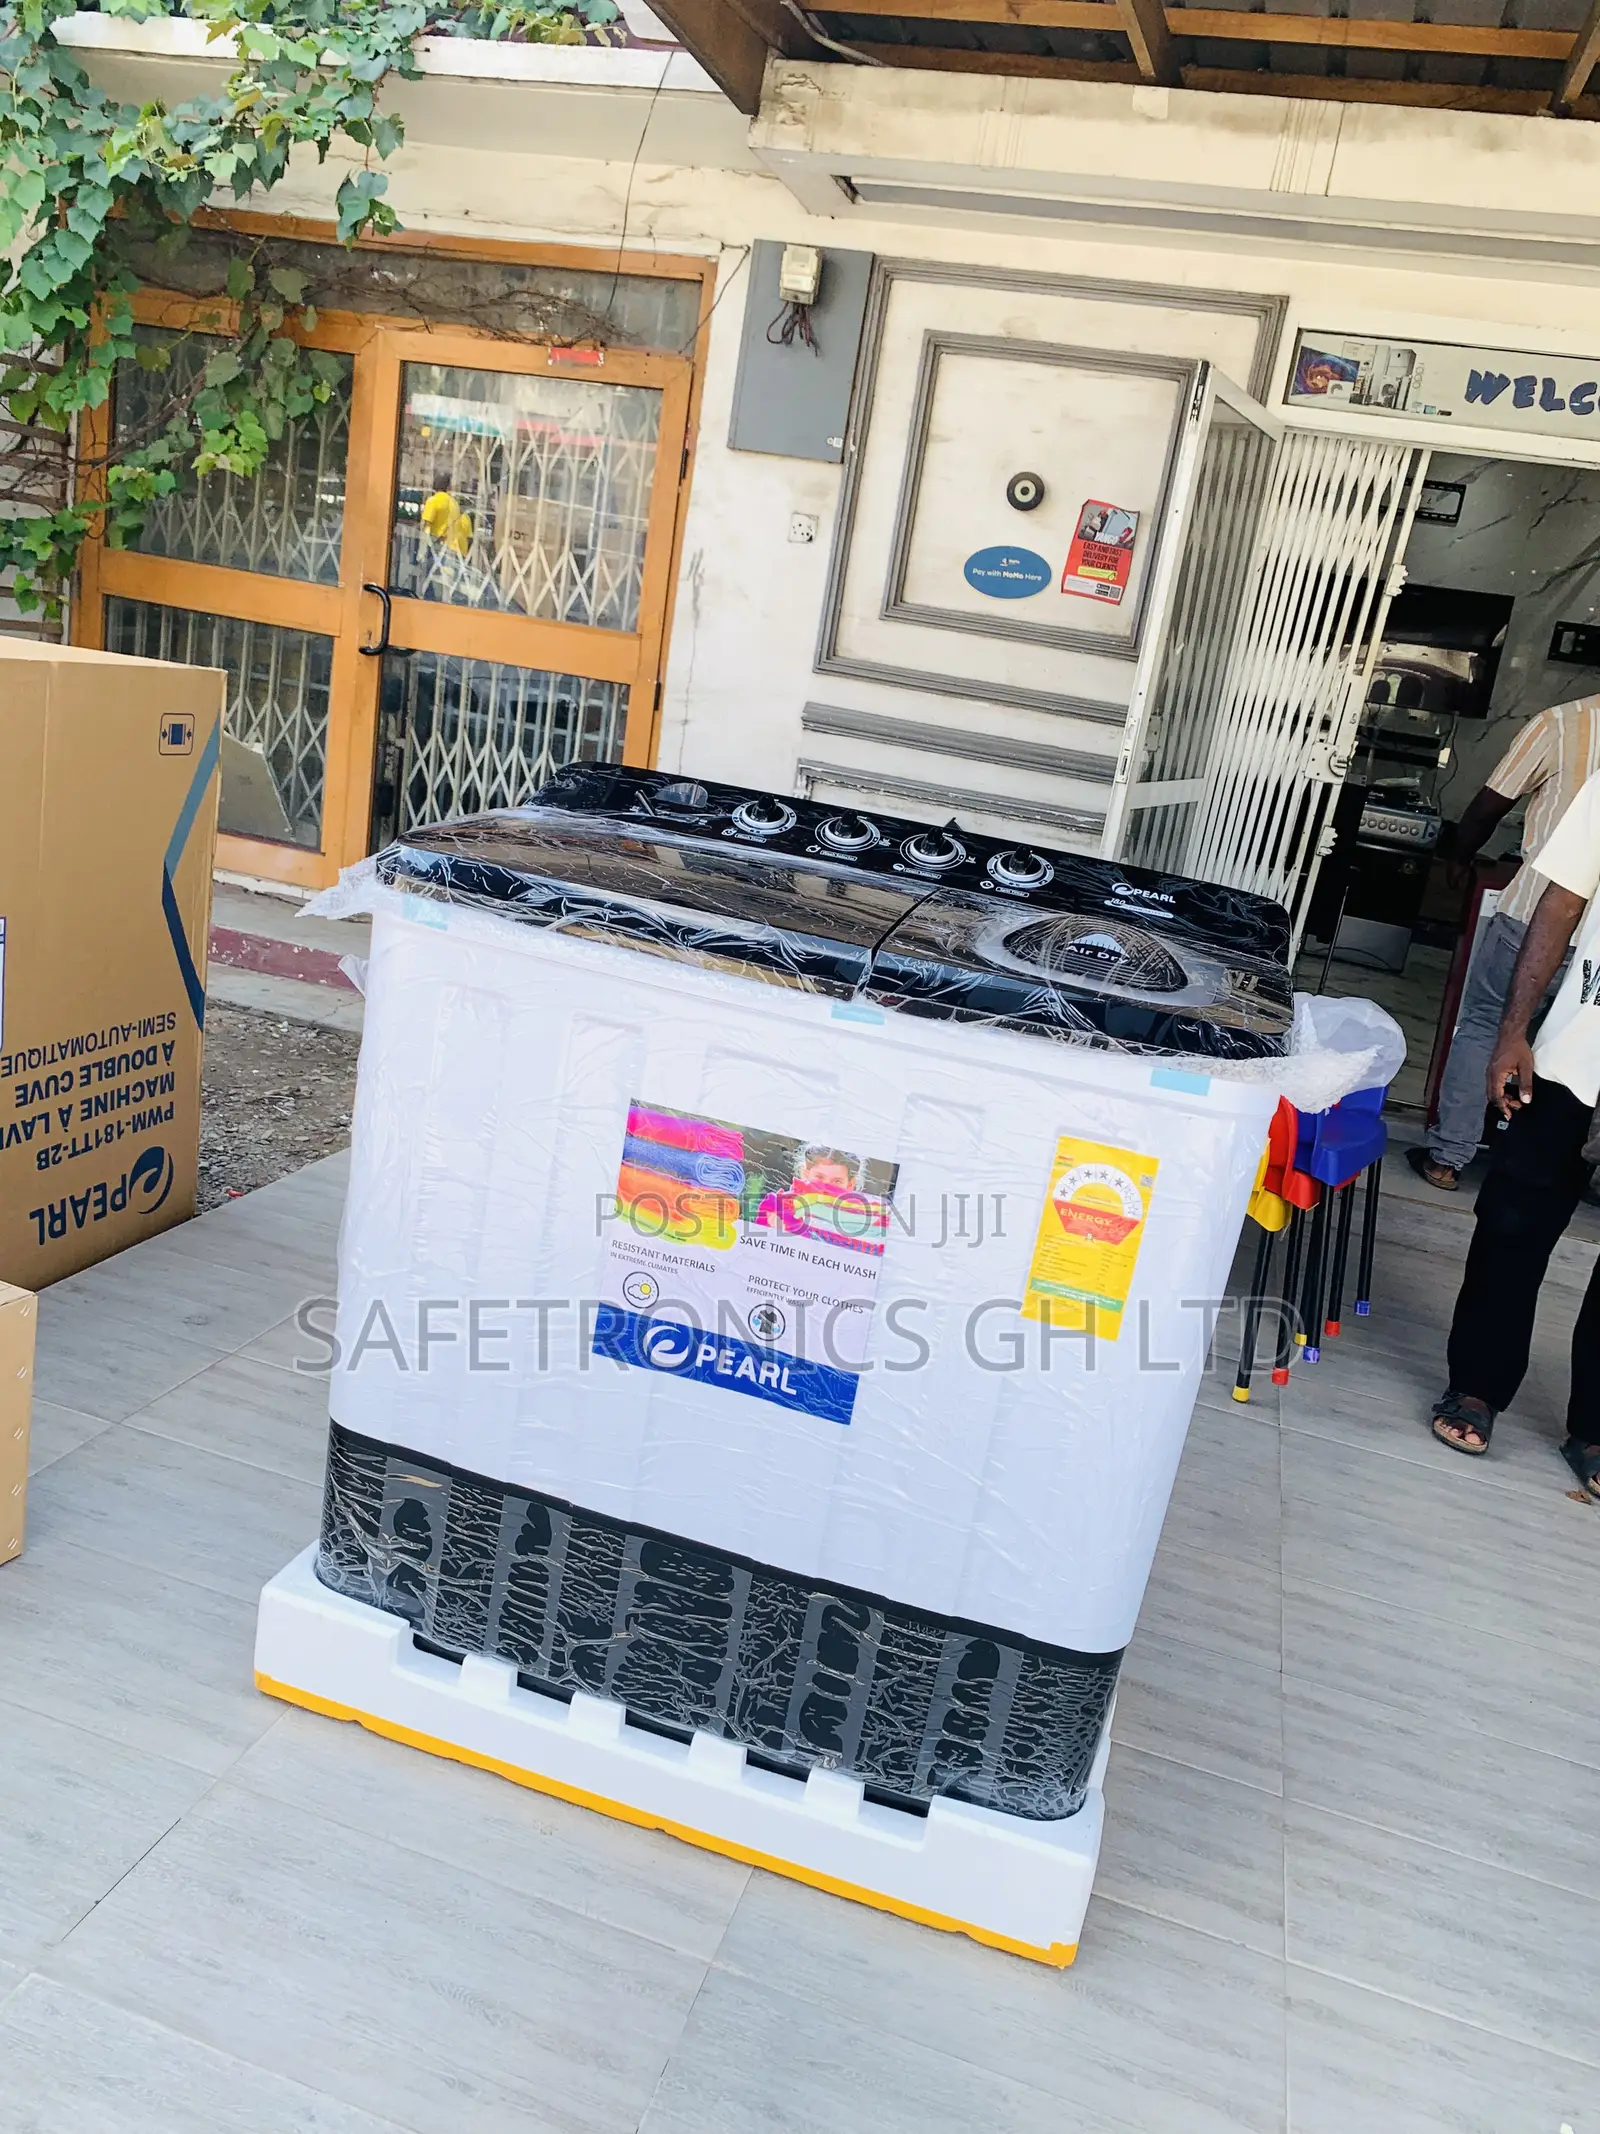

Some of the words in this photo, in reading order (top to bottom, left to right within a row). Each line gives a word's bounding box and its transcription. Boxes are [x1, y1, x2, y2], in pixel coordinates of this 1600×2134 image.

[1464, 368, 1600, 416] WELC
[1083, 542, 1097, 550] EASY
[1083, 550, 1107, 561] DELIVERY
[973, 568, 985, 576] Pay
[1025, 573, 1042, 581] Here
[1133, 888, 1176, 904] PEARL
[1, 1012, 176, 1078] SEMI-AUTOMATIQUE
[79, 1045, 157, 1087] DOUBLE
[15, 1071, 74, 1108] CUVE
[80, 1071, 175, 1121] MACHINE
[36, 1101, 175, 1170] PWM-181TT-2B
[29, 1173, 127, 1245] PEARL
[1060, 1208, 1113, 1225] ENERGY
[612, 1240, 660, 1259] RESISTANT
[662, 1254, 715, 1273] MATERIALS
[618, 1253, 647, 1267] EXTREME
[647, 1261, 678, 1274] CLIMATES
[740, 1235, 767, 1250] SAVE
[770, 1242, 796, 1258] TIME
[797, 1251, 809, 1262] IN
[811, 1255, 840, 1271] EACH
[844, 1263, 877, 1280] WASH
[746, 1286, 784, 1301] EFFICIENTLY
[748, 1274, 791, 1293] PROTECT
[793, 1286, 819, 1301] YOUR
[821, 1295, 864, 1314] CLOTHES
[695, 1343, 797, 1395] PEARL
